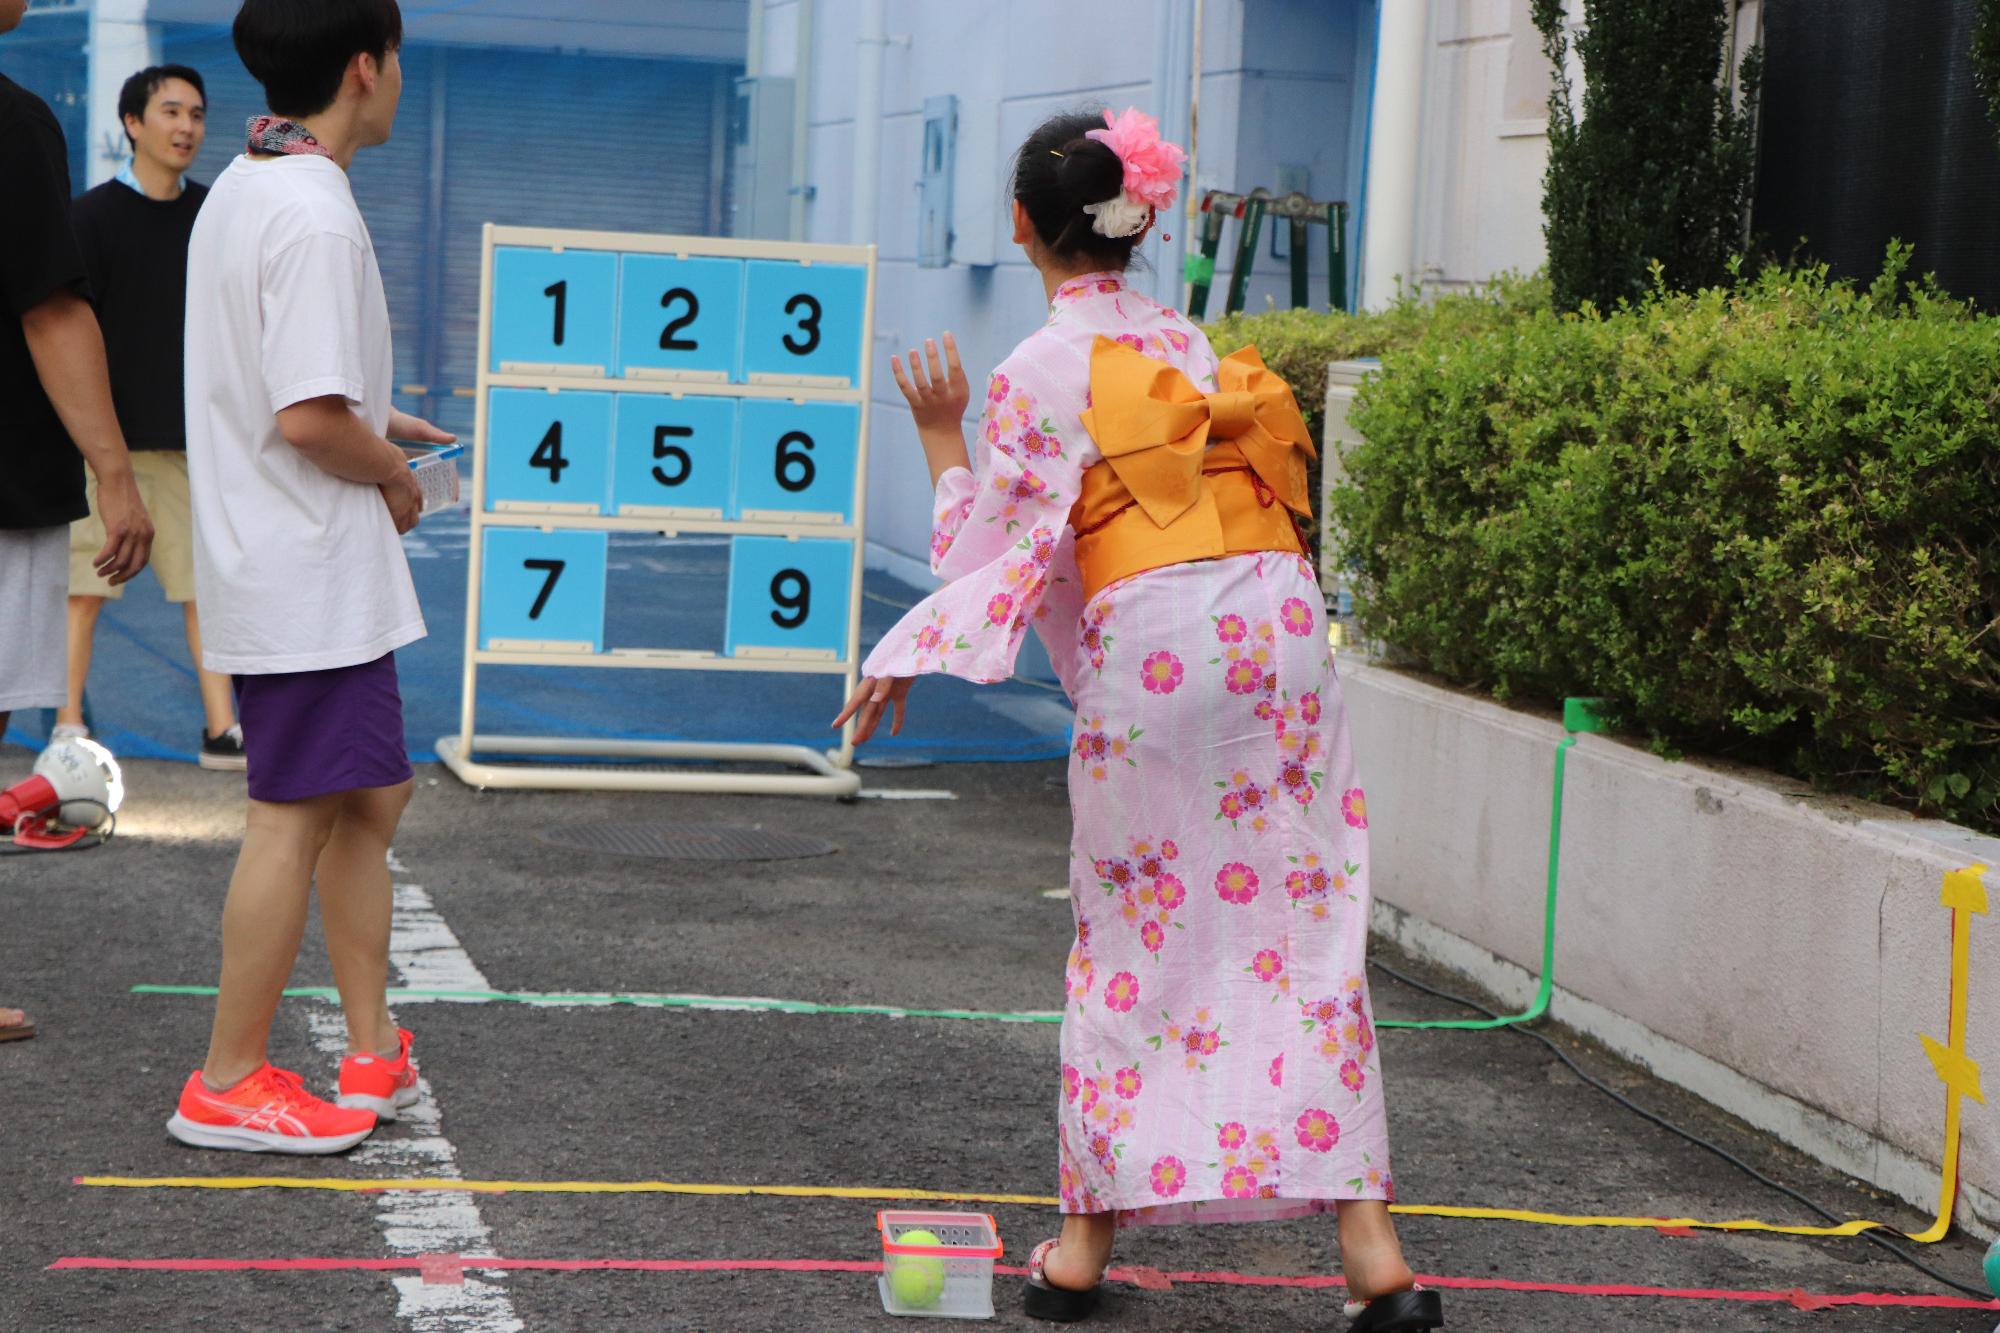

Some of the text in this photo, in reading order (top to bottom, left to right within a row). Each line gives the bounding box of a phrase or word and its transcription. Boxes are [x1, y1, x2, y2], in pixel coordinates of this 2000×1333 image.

[543, 280, 823, 356] 1 2 3
[528, 420, 816, 493] 4 5 6
[523, 558, 811, 630] 7 9
